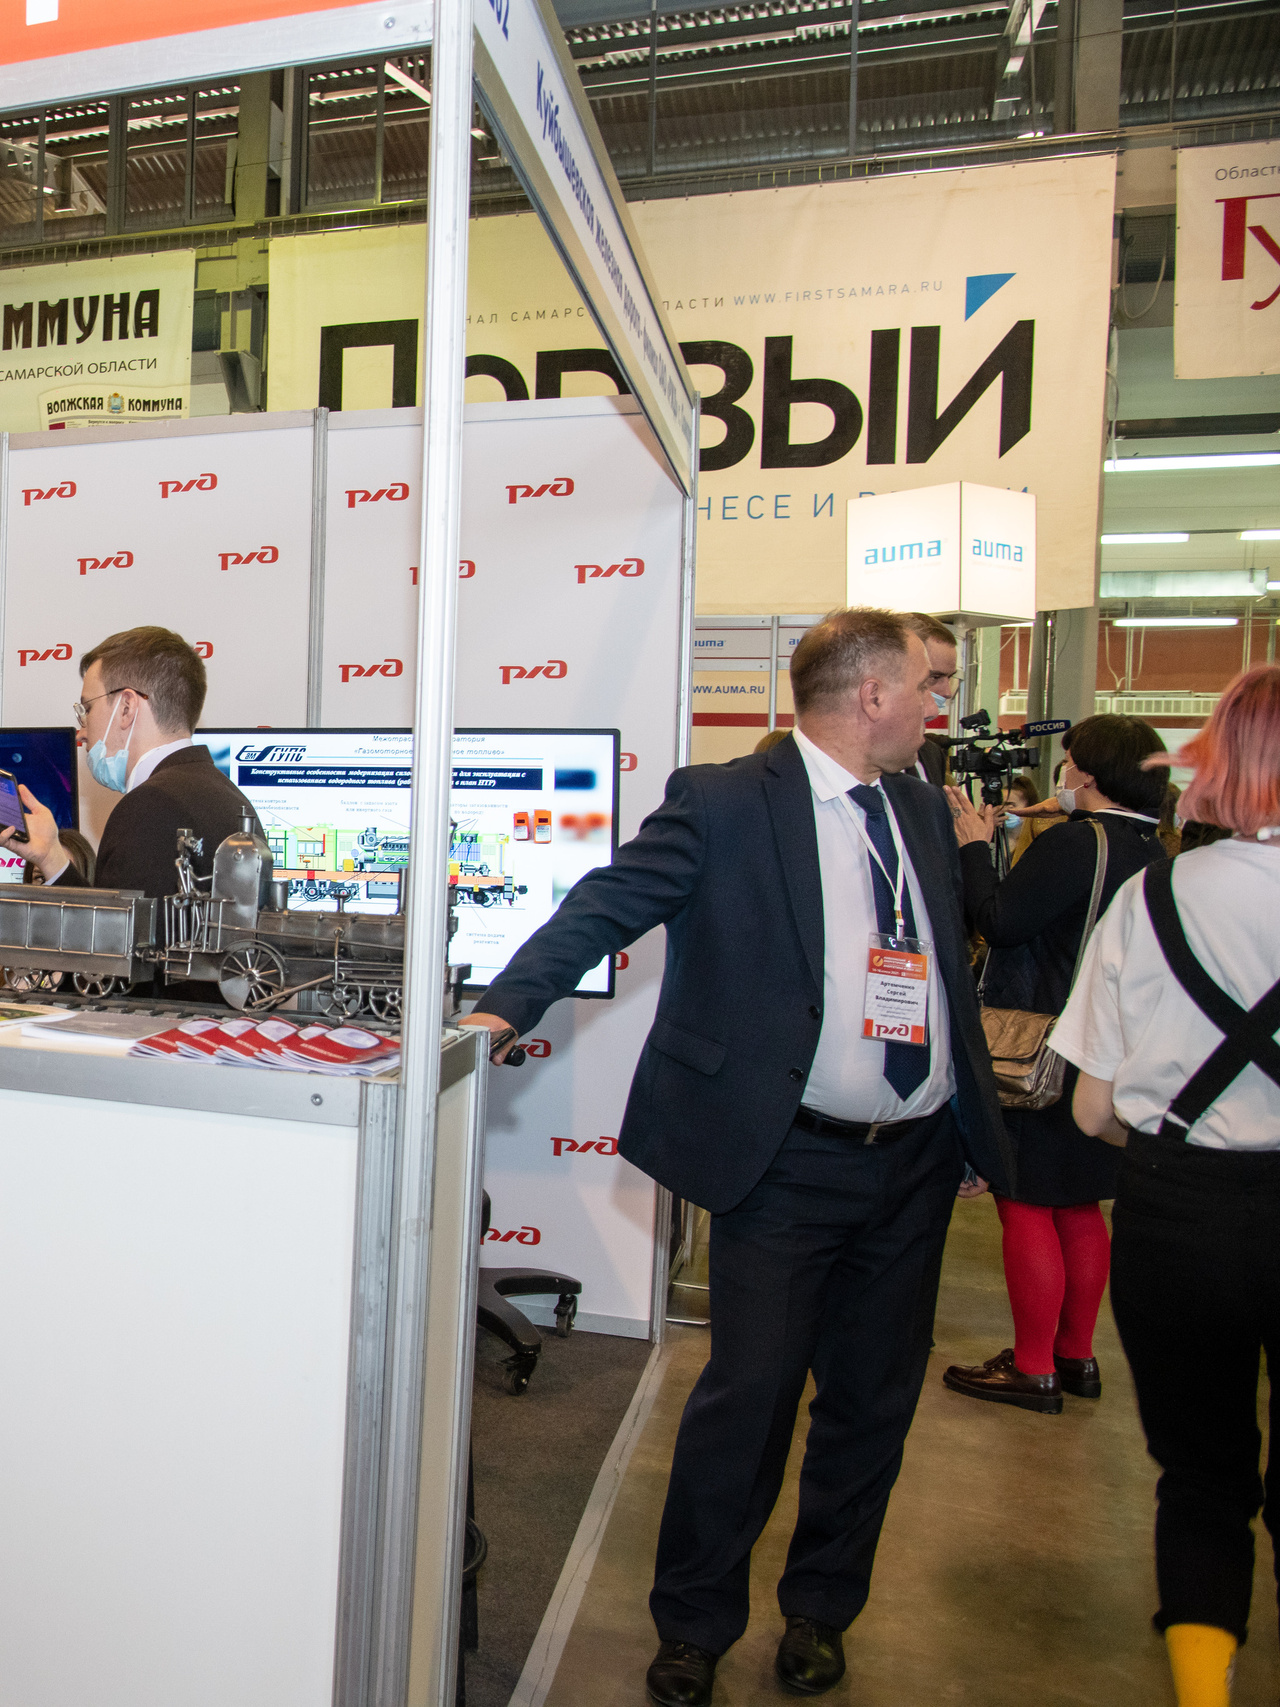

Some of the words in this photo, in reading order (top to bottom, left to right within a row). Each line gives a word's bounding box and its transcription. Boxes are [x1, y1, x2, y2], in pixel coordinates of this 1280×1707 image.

[510, 306, 586, 323] САМАРС
[733, 280, 944, 306] WWW.FIRSTSAMARA.RU
[87, 357, 158, 375] ОБЛАСТИ
[46, 396, 104, 415] ВОЛЖСКАЯ
[127, 397, 183, 412] КОММУНА
[864, 540, 941, 565] auma
[972, 538, 1023, 563] auma
[1029, 721, 1066, 733] РОССИЯ
[306, 768, 347, 776] особенности
[348, 769, 395, 777] модернизации
[472, 771, 520, 779] эксплуатации
